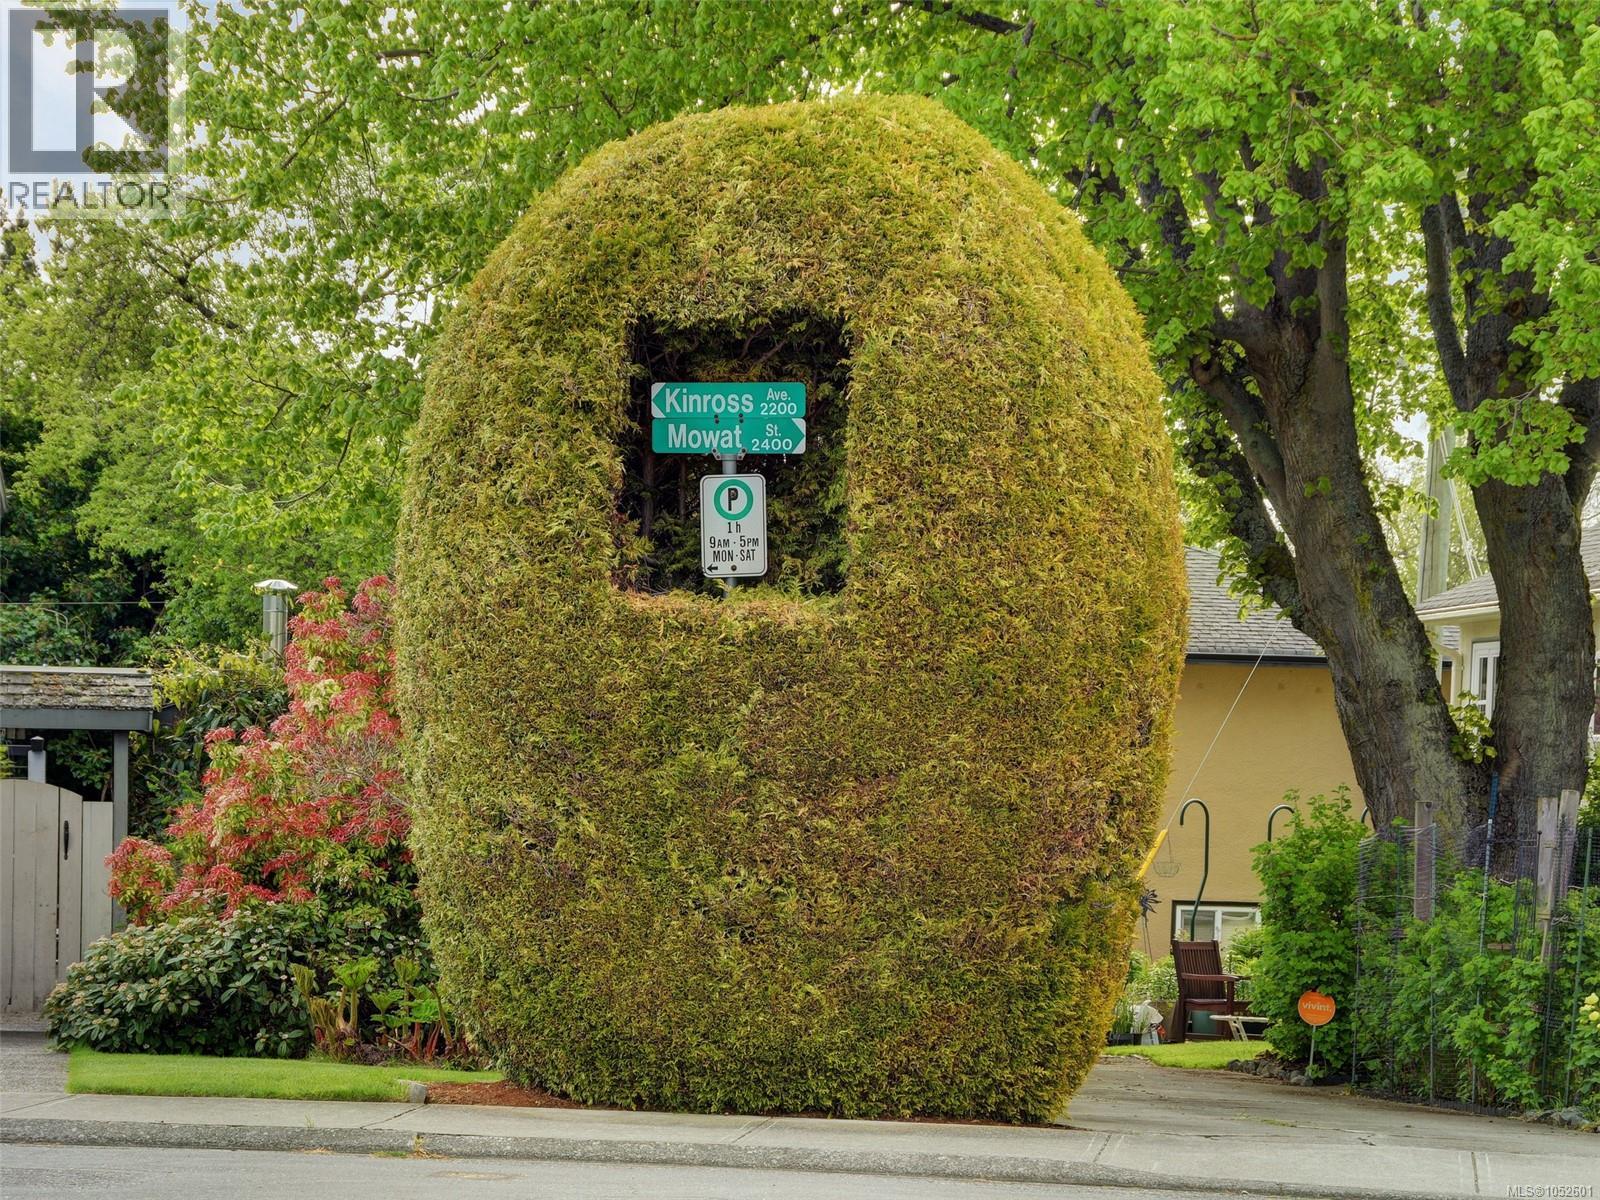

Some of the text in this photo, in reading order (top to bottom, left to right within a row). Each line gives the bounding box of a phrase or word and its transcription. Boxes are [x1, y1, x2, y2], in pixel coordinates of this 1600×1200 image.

[665, 388, 791, 413] Kinross Ave.
[760, 402, 797, 415] 2200
[668, 423, 782, 449] Mowat St.
[752, 438, 793, 451] 2400
[727, 487, 739, 511] P
[727, 521, 741, 534] 1 h
[709, 536, 730, 549] 9AM
[739, 535, 760, 548] 5PM
